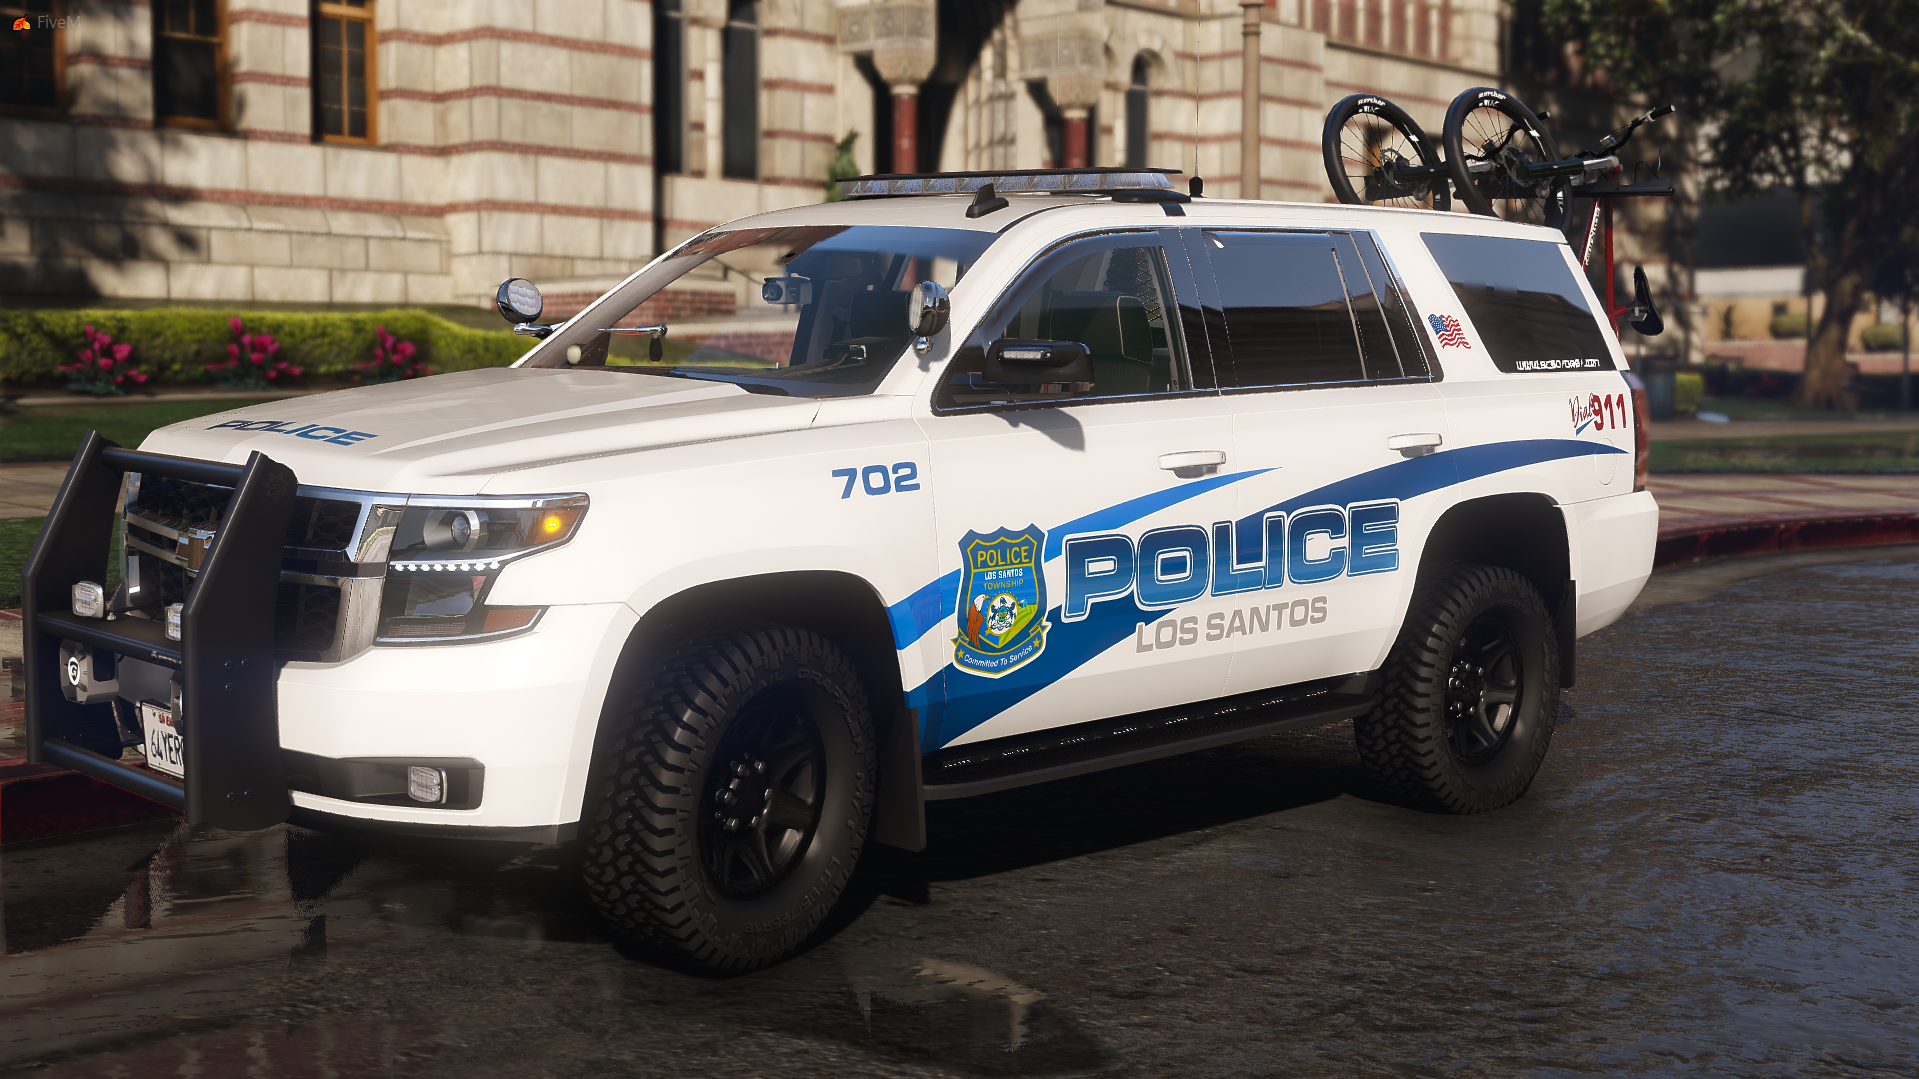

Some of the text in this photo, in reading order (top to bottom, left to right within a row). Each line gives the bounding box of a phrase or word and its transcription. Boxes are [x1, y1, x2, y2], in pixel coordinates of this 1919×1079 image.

[1568, 392, 1627, 432] Dial 911
[203, 419, 380, 447] POLICE
[831, 461, 921, 500] 702
[977, 545, 1030, 568] POLICE
[1061, 497, 1400, 623] POLICE
[983, 578, 1024, 591] TOWNSHIP
[984, 567, 1023, 581] LOS SANTOS
[1135, 595, 1328, 654] LOS SANTOS
[963, 645, 1033, 668] Committed To Service
[794, 667, 864, 755] GRAPPLER
